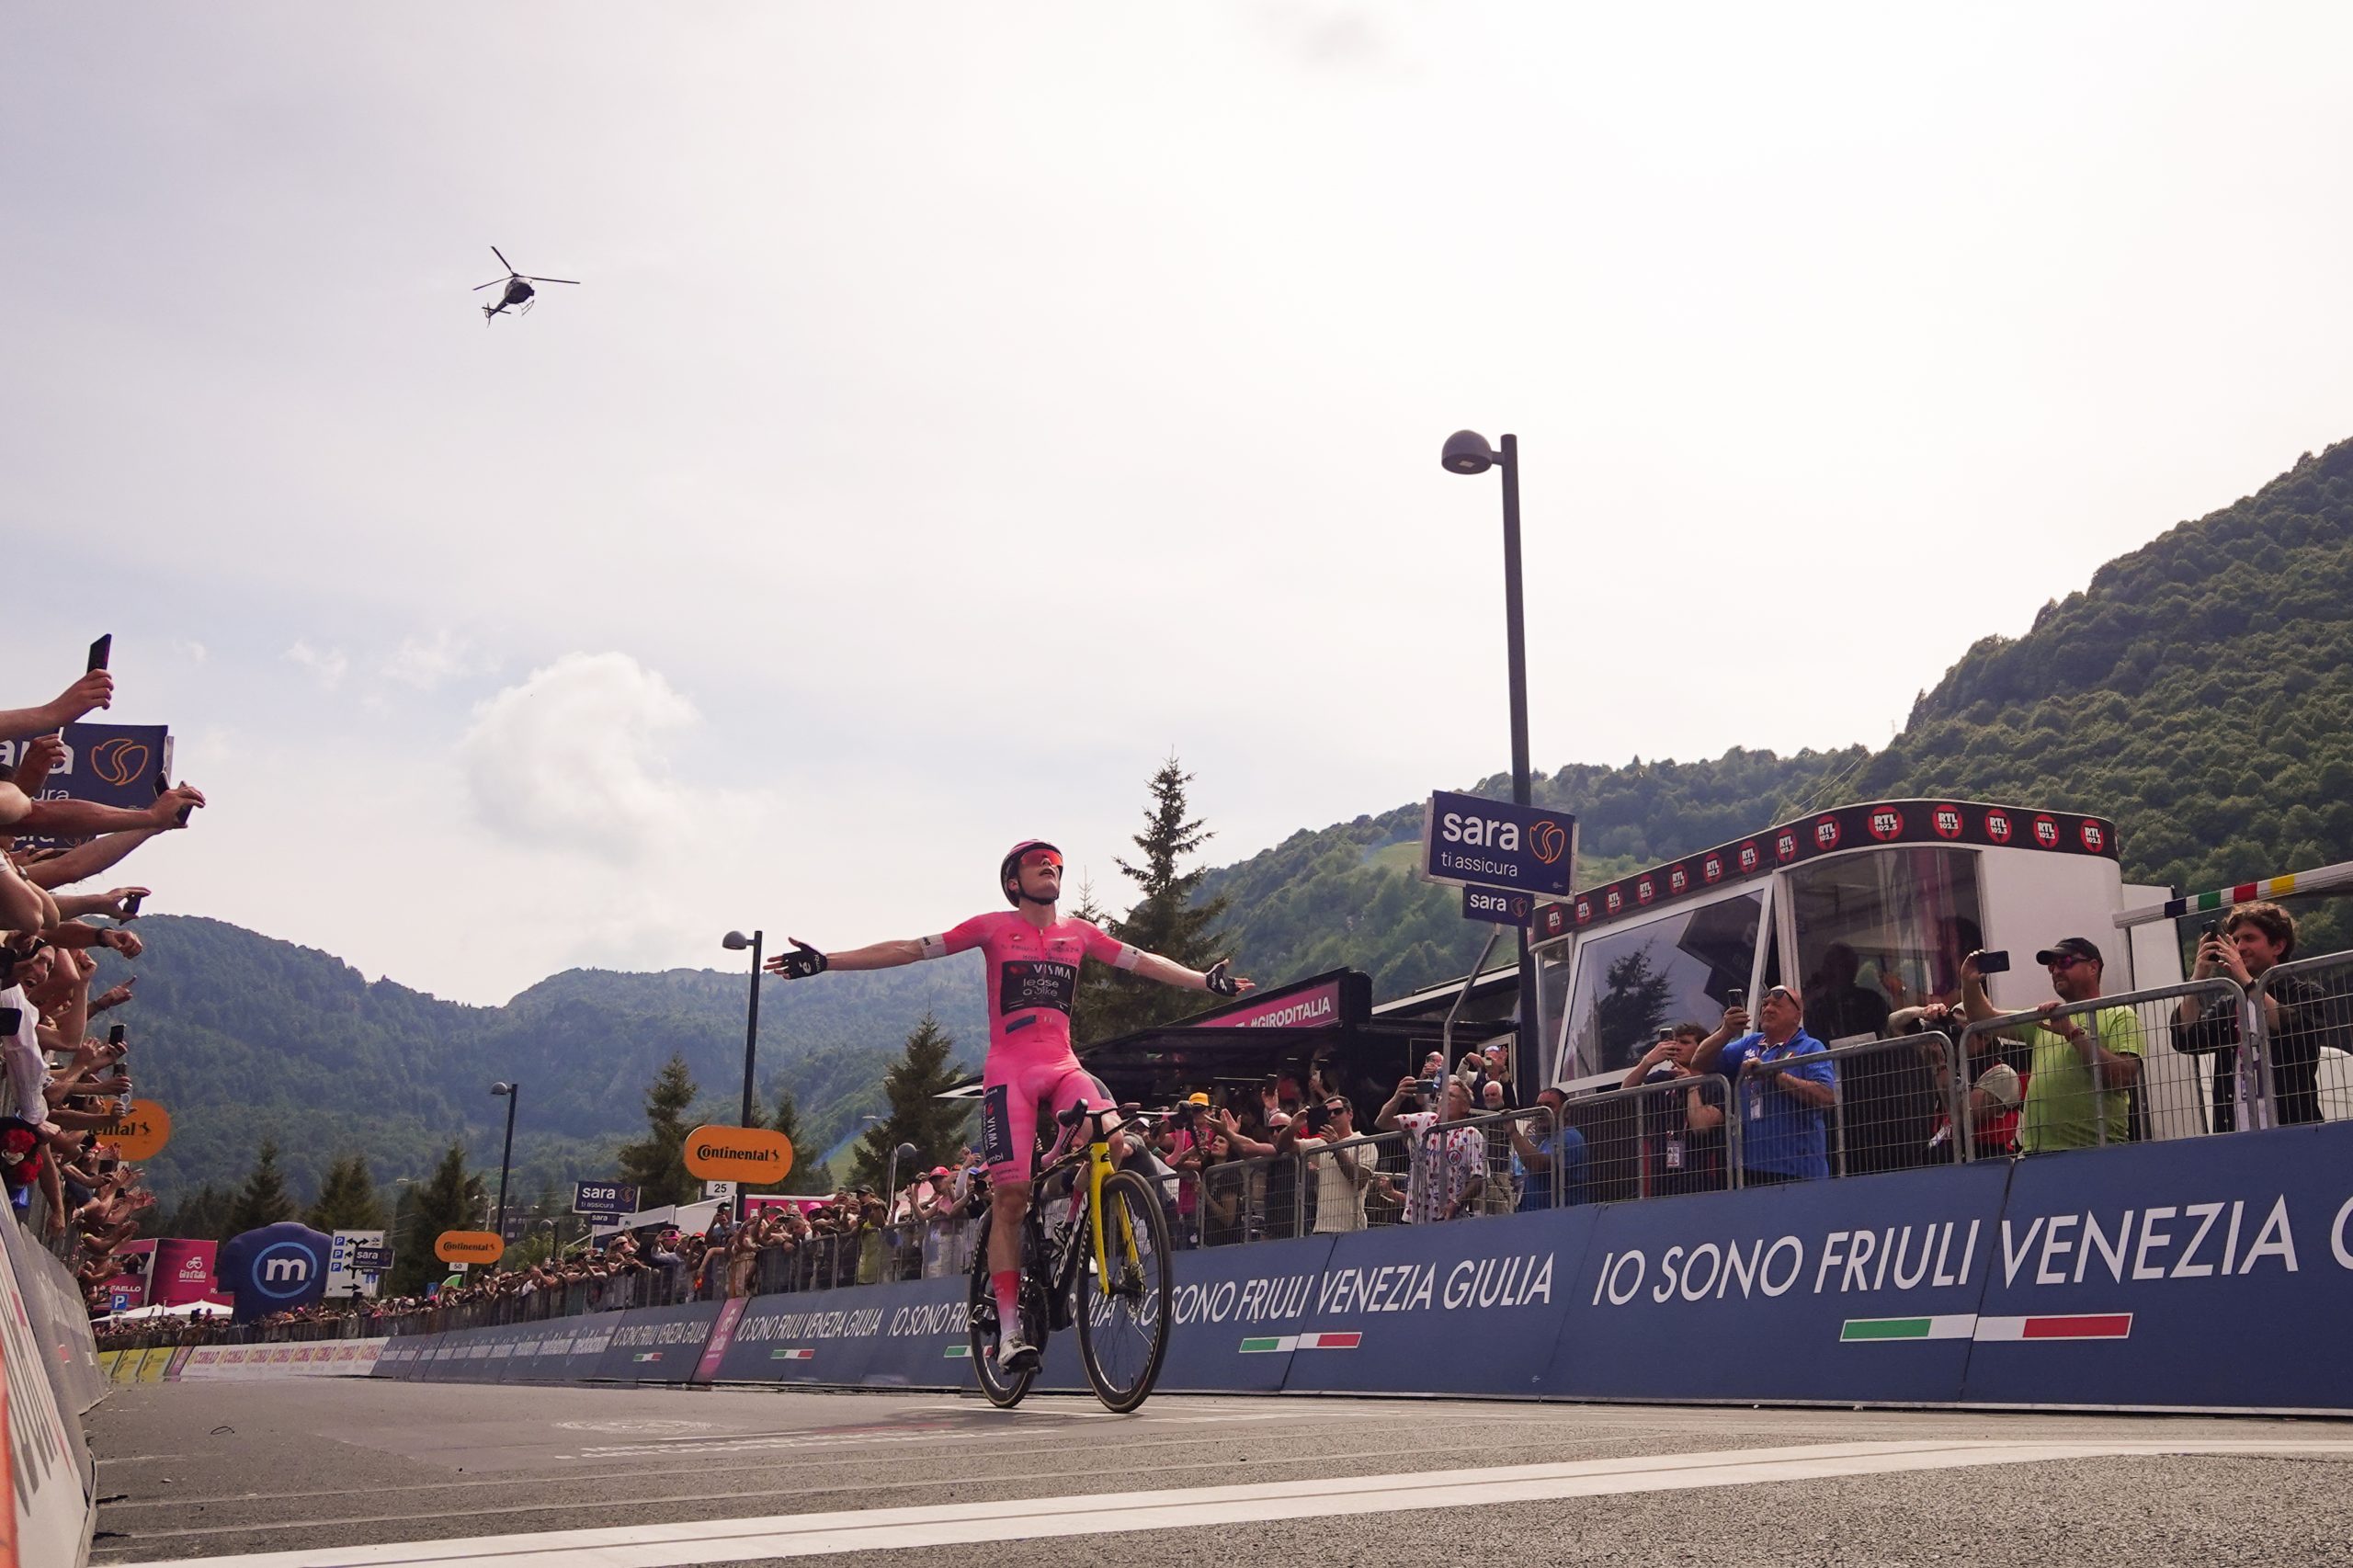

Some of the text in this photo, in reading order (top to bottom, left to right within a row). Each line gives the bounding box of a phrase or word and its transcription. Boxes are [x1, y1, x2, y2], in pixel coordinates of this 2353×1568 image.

[1873, 813, 1896, 826] RTL
[1938, 812, 1958, 824] RTL
[1989, 816, 2006, 828] RTL
[1442, 812, 1519, 851] sara
[1818, 824, 1835, 835] RTL
[1875, 823, 1897, 833] 102.5
[1939, 822, 1959, 830] 102.5
[1991, 826, 2007, 835] 102.5
[2038, 822, 2054, 834] RTL
[1819, 833, 1836, 842] 102.5
[2039, 831, 2055, 840] 102.5
[2085, 827, 2100, 838] RTL
[1779, 836, 1792, 848] RTL
[2086, 836, 2101, 845] 102.5
[1742, 847, 1755, 859] RTL
[1441, 851, 1518, 877] ti assicura
[1707, 859, 1719, 871] RTL
[1672, 871, 1684, 882] RTL
[1640, 882, 1651, 892] RTL
[1471, 893, 1506, 912] sara
[1608, 892, 1620, 903] RTL
[1578, 903, 1588, 913] RTL
[1549, 911, 1560, 921] RTL
[1033, 964, 1071, 980] VISMA
[1023, 978, 1059, 988] lease
[1251, 996, 1331, 1027] #GIRODITALIA
[697, 1144, 769, 1161] Continental
[582, 1187, 616, 1199] sara
[714, 1184, 727, 1193] 25
[443, 1242, 489, 1251] Continental
[1592, 1249, 1646, 1306] IO
[1654, 1235, 1804, 1303] SONO
[1813, 1219, 1981, 1294] FRIULI
[2001, 1194, 2299, 1290] VENEZIA
[357, 1251, 379, 1259] sara
[265, 1258, 307, 1281] m
[1171, 1281, 1235, 1324] SONO
[1234, 1274, 1314, 1322] FRIULI
[1316, 1262, 1436, 1315] VENEZIA
[1443, 1252, 1554, 1310] GIULIA
[115, 1296, 125, 1308] P
[734, 1308, 883, 1342] IO SONO FRIULI VENEZIA GIULIA
[887, 1306, 909, 1336] IO
[904, 1302, 949, 1335] SONO
